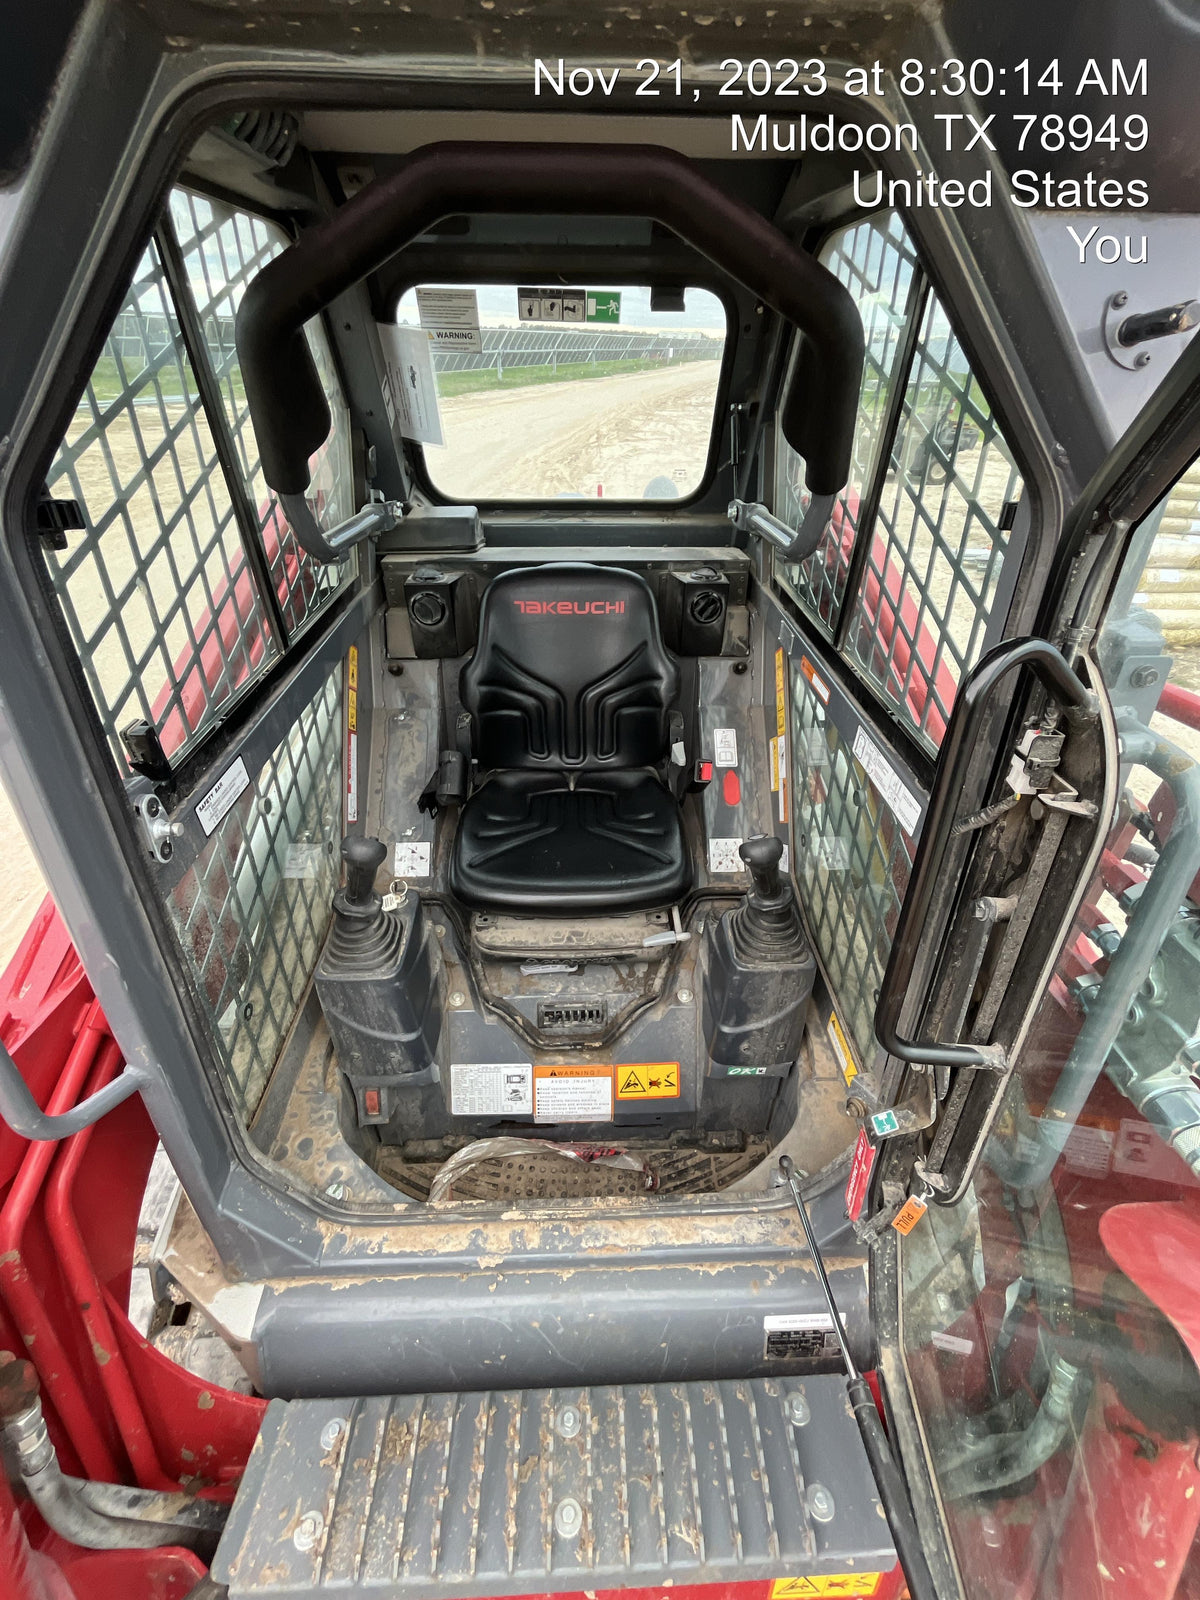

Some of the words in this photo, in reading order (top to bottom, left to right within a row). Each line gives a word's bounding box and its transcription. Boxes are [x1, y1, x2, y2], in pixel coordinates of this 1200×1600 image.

[199, 792, 214, 812] SAFETY
[214, 781, 223, 793] BAR
[728, 1066, 757, 1076] OK
[895, 1211, 915, 1231] PULL
